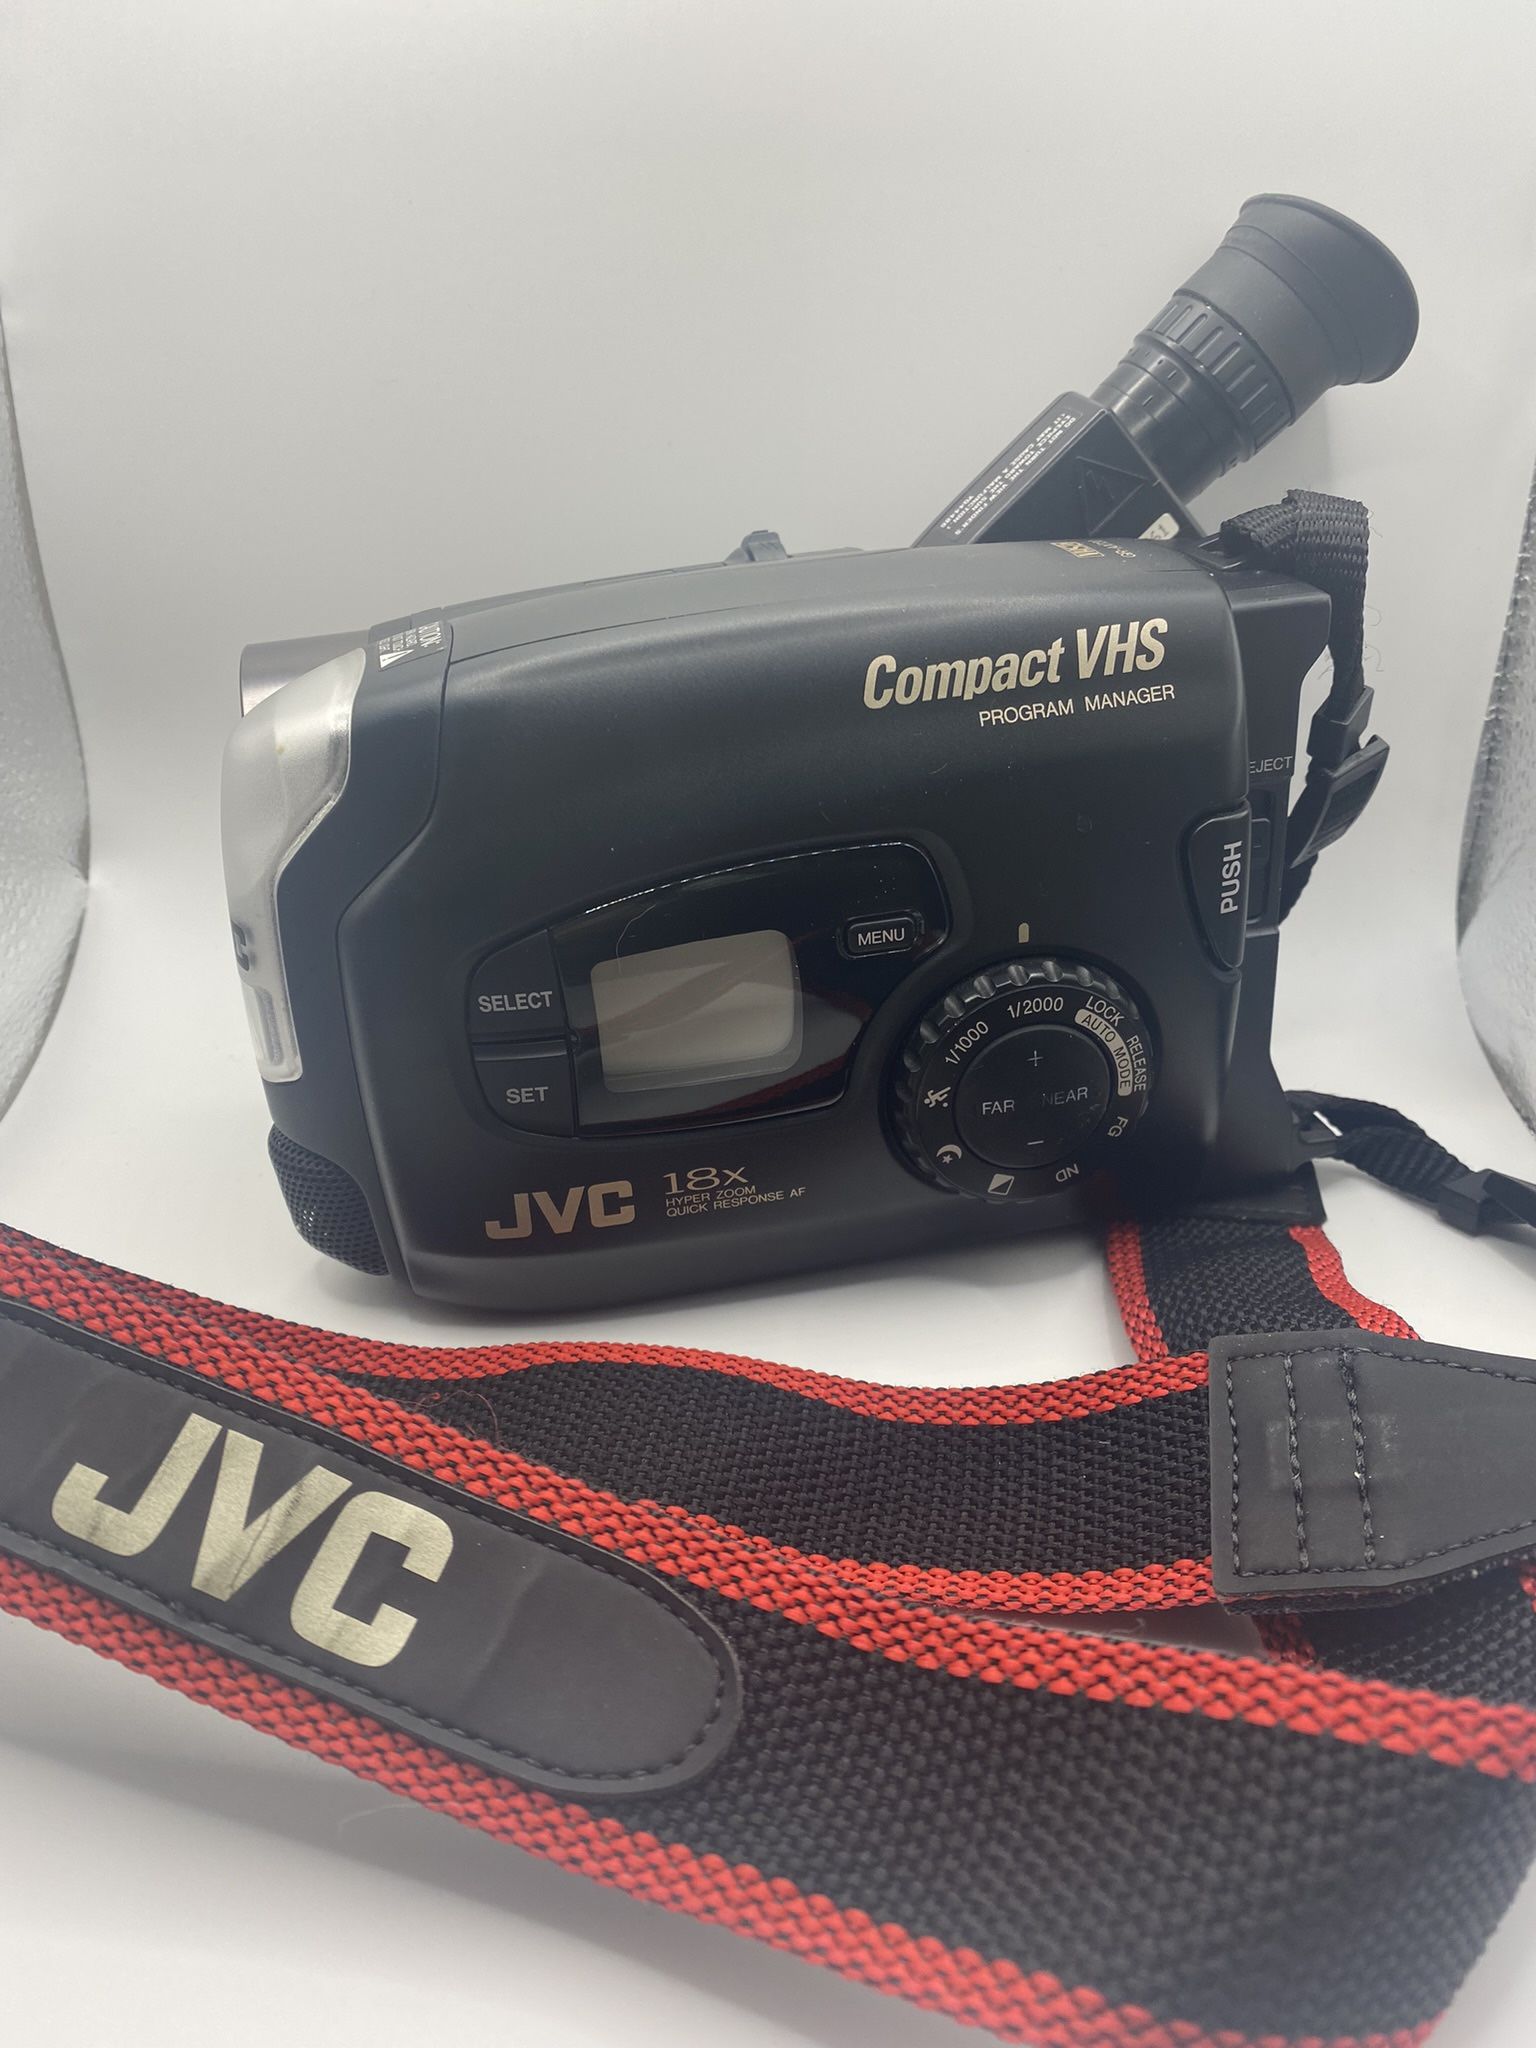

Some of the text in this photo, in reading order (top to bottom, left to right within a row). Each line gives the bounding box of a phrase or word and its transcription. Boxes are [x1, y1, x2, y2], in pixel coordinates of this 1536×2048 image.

[1036, 415, 1071, 447] EYEPIECE
[1036, 426, 1052, 442] MAY
[1048, 429, 1063, 444] NOT
[1004, 451, 1035, 479] TOWARD
[1009, 443, 1035, 466] CAUSE
[1025, 447, 1046, 465] TURN
[1008, 467, 1024, 482] THE
[989, 484, 1009, 501] VIEW
[863, 618, 1168, 710] Compact VHS
[979, 684, 1175, 727] PROGRAM MANAGER
[1220, 840, 1242, 914] PUSH
[857, 927, 906, 946] MENU
[478, 991, 553, 1013] SELECT
[1007, 996, 1064, 1019] 1/2000
[945, 1020, 989, 1066] 1/1000
[1081, 1013, 1131, 1089] AUTO MODE
[1085, 995, 1147, 1092] LOCK RELEASE
[506, 1086, 548, 1104] SET
[982, 1099, 1015, 1116] FAR
[1107, 1115, 1128, 1138] FG
[1055, 1163, 1080, 1183] ND
[665, 1185, 756, 1207] HYPER ZOOM
[666, 1186, 806, 1217] QUICK RESPONSE AF
[485, 1180, 636, 1240] JVC
[51, 1412, 454, 1668] JVC
